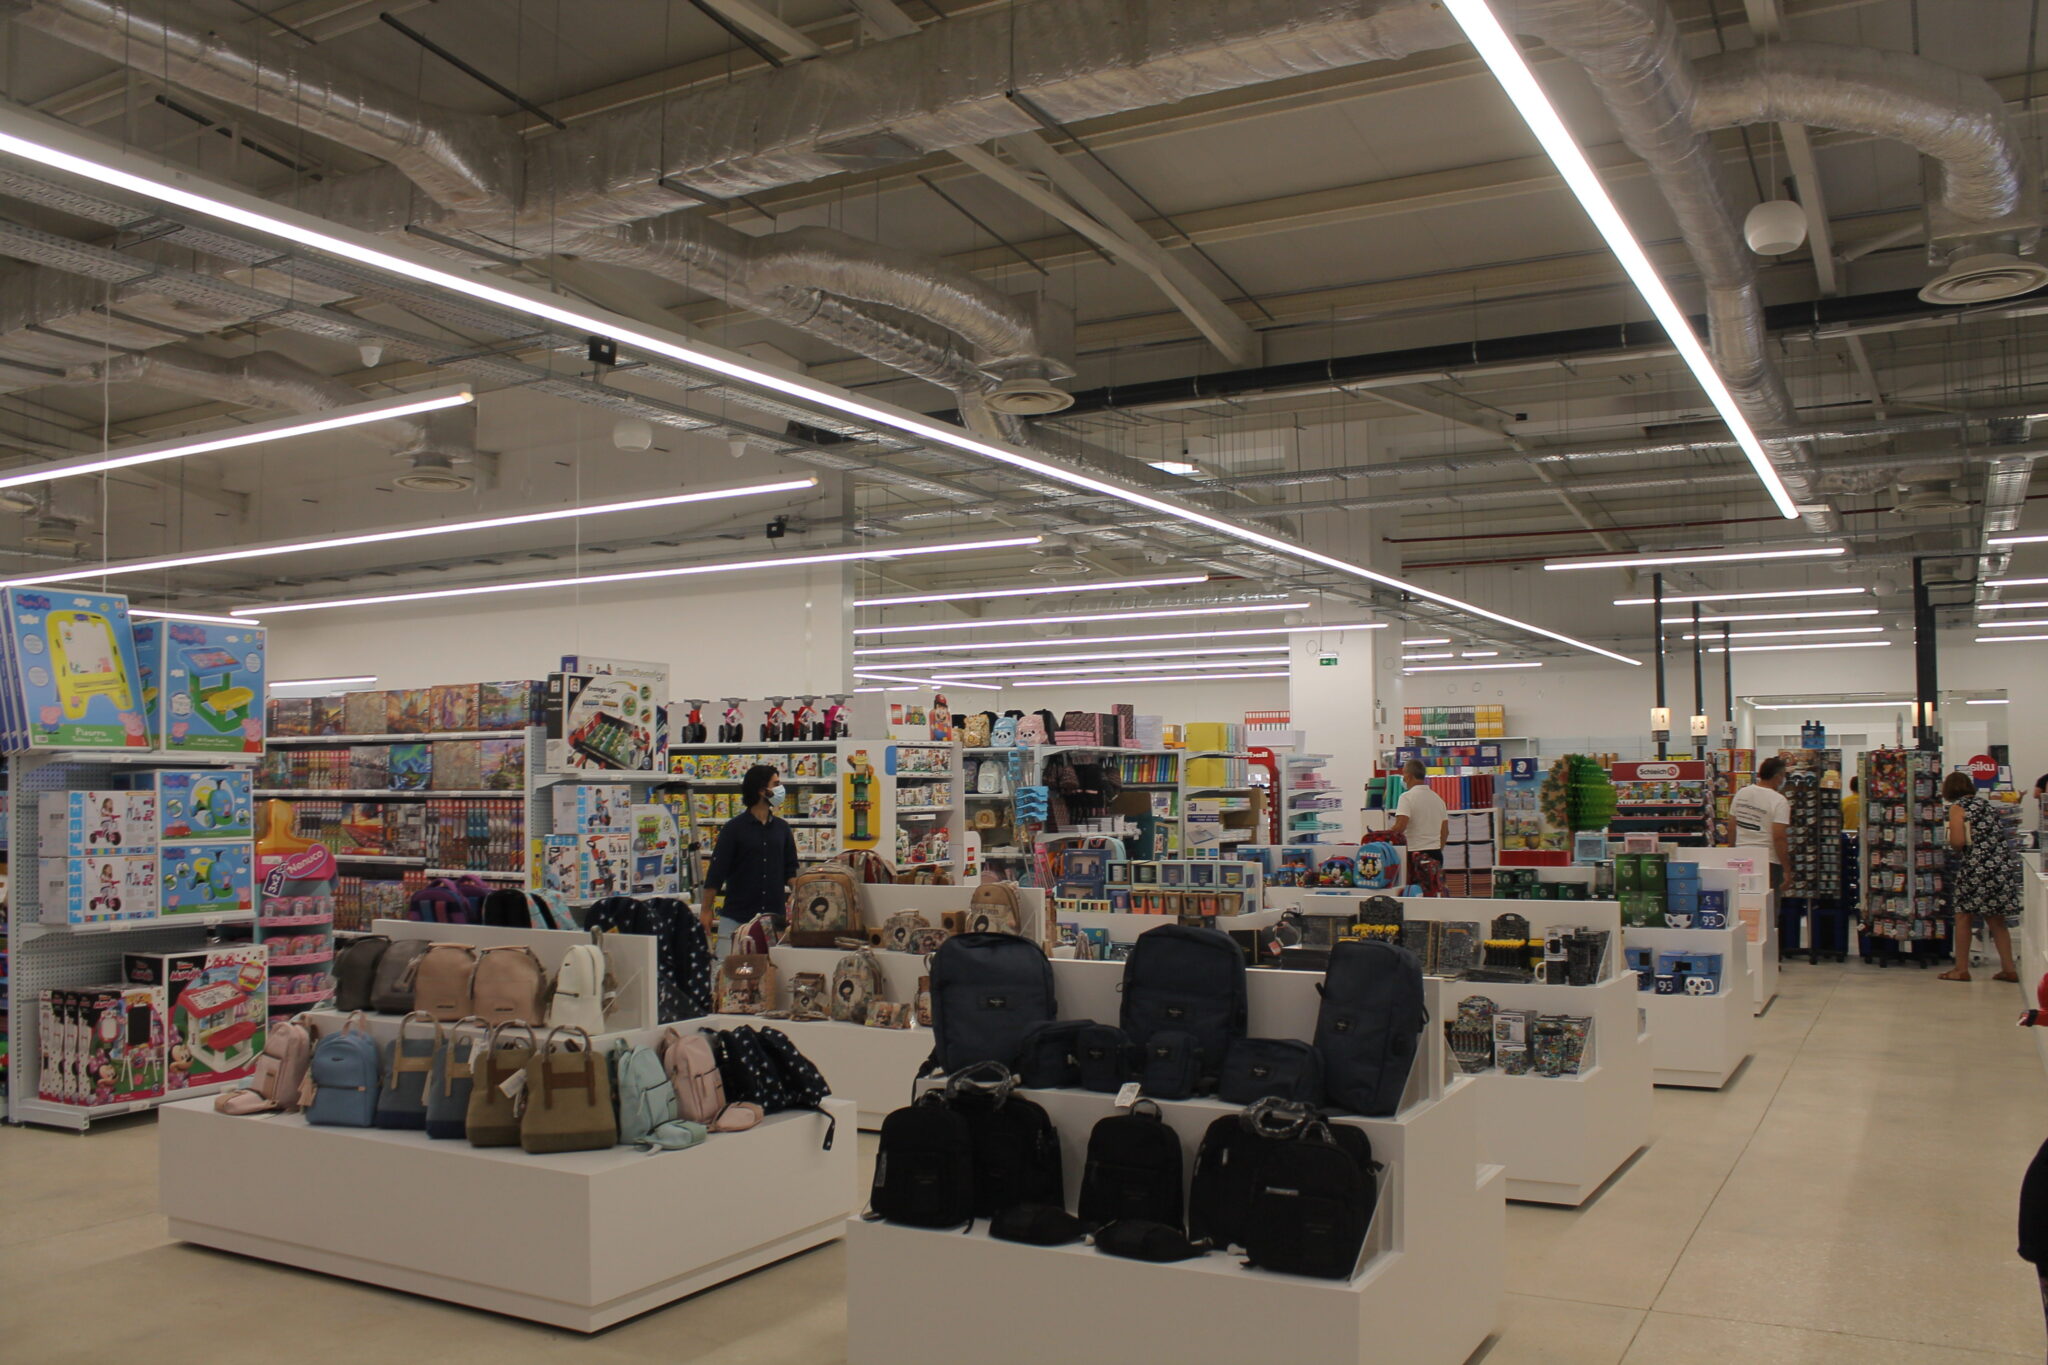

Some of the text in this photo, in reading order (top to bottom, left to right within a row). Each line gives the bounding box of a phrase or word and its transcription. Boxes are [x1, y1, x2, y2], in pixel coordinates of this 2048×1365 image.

[1970, 761, 1995, 771] siku
[69, 792, 82, 856] FEBER
[286, 850, 324, 874] Nenuco
[69, 860, 82, 924] FEBER
[1702, 915, 1716, 926] 93
[1658, 980, 1673, 992] 93
